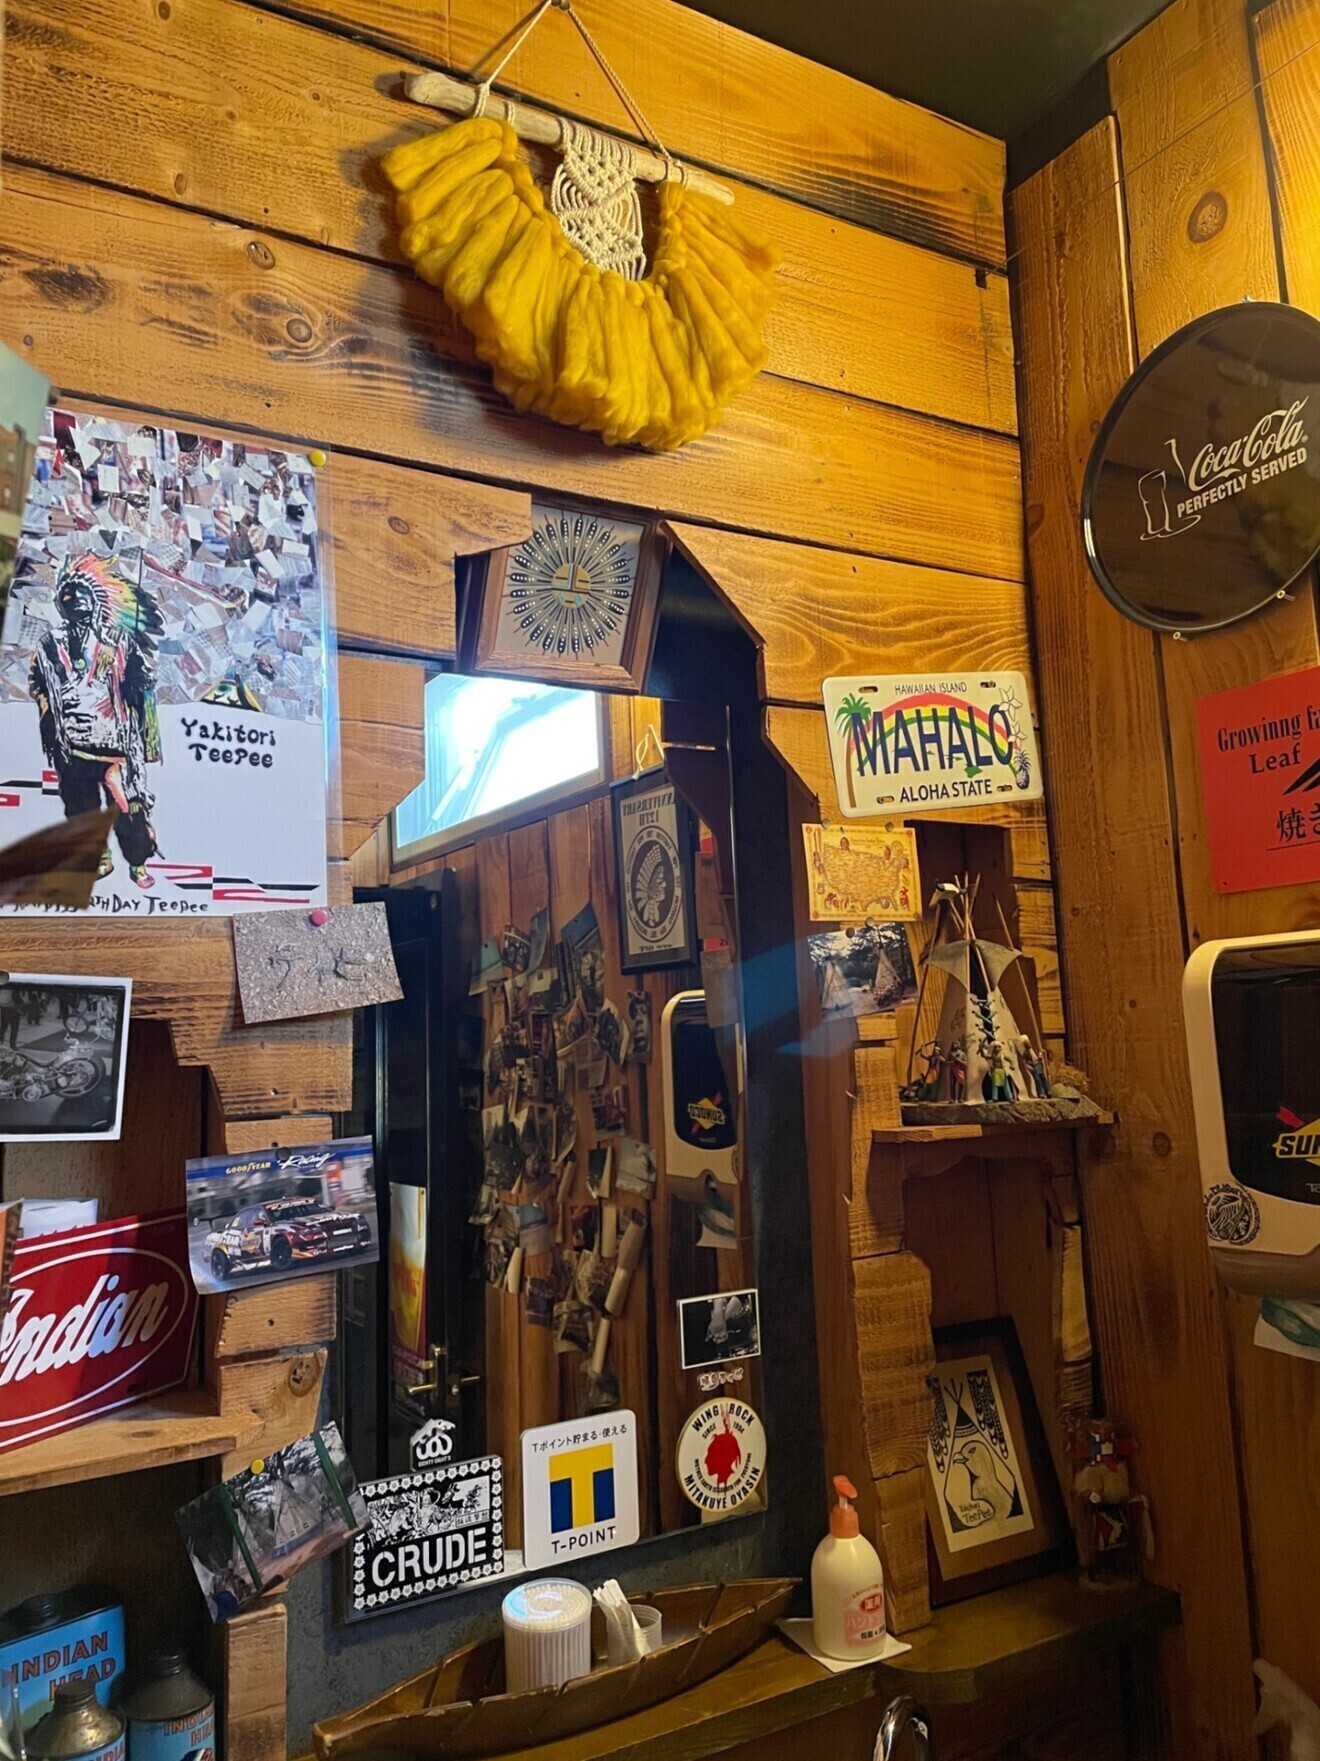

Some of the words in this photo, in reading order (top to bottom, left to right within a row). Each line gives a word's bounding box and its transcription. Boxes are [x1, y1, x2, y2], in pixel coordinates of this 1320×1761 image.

[1188, 395, 1309, 492] Coca-Cola
[1176, 473, 1248, 519] PERFECTLY
[1251, 447, 1308, 485] SERVED
[894, 682, 936, 695] HAWAIIAN
[938, 681, 968, 694] ISLAND
[180, 717, 276, 747] Yakitori
[850, 704, 1014, 778] MAHALO
[1217, 713, 1303, 753] Growinng
[1248, 742, 1302, 775] Leaf
[899, 783, 950, 803] ALOHA
[952, 779, 993, 798] STATE
[692, 1405, 719, 1432] WING
[728, 1403, 755, 1426] ROCK
[702, 1422, 717, 1439] SINCE
[684, 1473, 728, 1511] MITAKUYE
[730, 1466, 761, 1506] OYASIN
[371, 1527, 487, 1588] CRUDE
[551, 1525, 616, 1554] T-POINT
[9, 1630, 109, 1686] INDIAN
